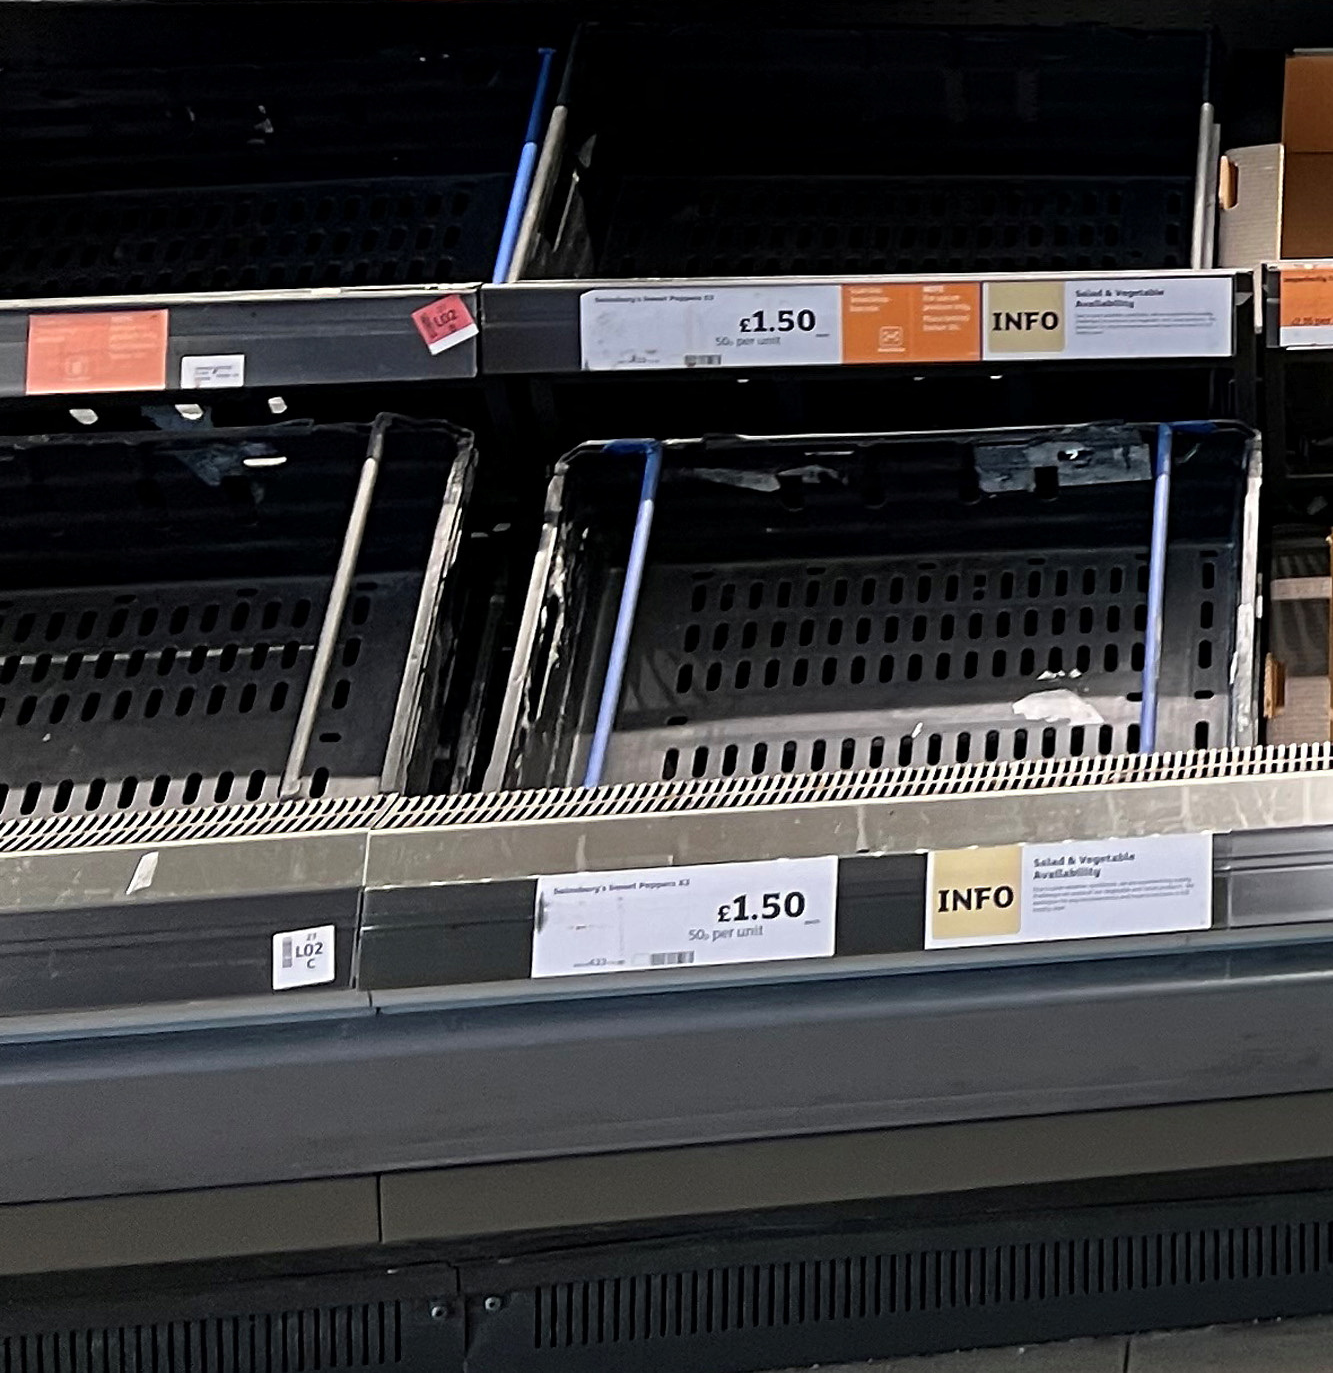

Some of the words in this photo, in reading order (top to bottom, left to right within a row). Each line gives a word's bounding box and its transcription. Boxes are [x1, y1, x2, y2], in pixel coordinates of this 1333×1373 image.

[1075, 289, 1102, 298] Salad
[1115, 288, 1165, 298] Vegetable
[739, 309, 816, 333] £1.50
[992, 311, 1060, 332] INFO
[736, 338, 756, 348] per
[757, 336, 781, 346] unit
[1033, 856, 1065, 867] Salad
[1068, 856, 1076, 866] &
[1079, 852, 1136, 866] Vegetable
[1033, 867, 1101, 880] Availability
[718, 891, 806, 923] £1.50
[938, 886, 1014, 913] INFO
[712, 929, 734, 942] per
[736, 925, 763, 938] unit
[296, 942, 323, 958] L02
[306, 958, 316, 969] C
